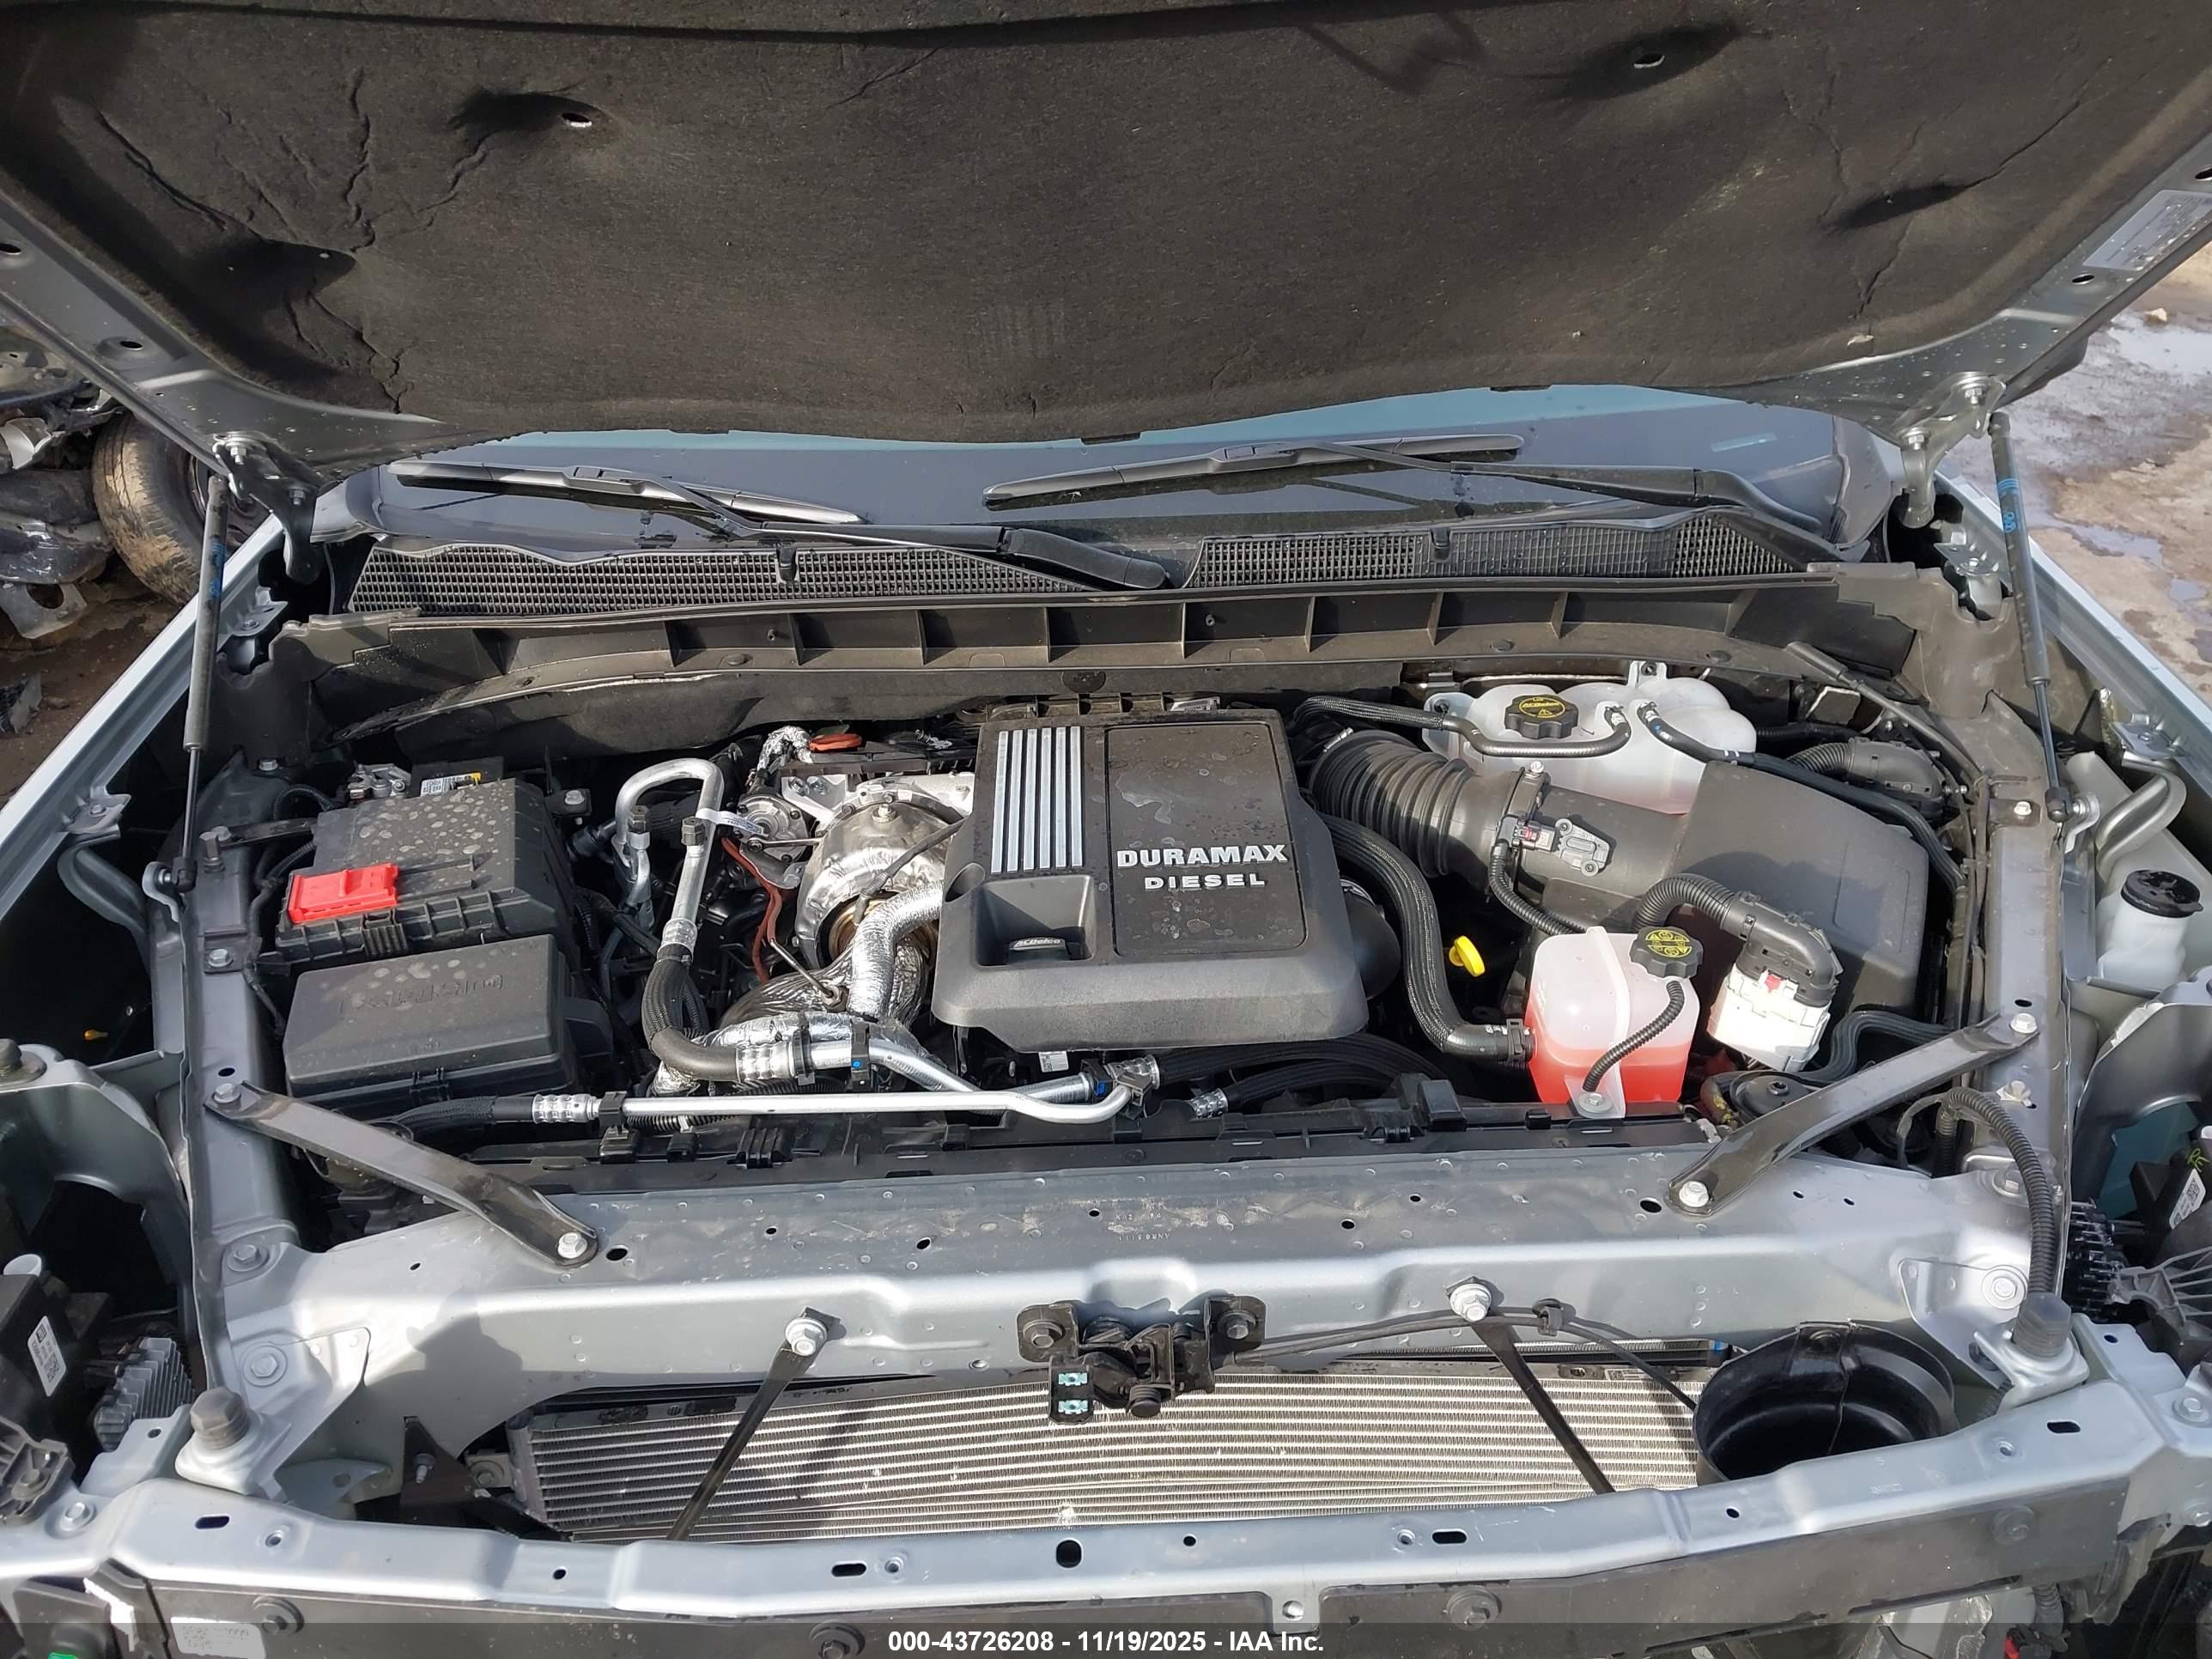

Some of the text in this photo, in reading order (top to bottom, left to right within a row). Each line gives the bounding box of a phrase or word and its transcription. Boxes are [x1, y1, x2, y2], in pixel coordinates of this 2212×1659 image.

[1116, 844, 1288, 867] DURAMAX
[1145, 872, 1266, 890] DIESEL
[1013, 938, 1061, 948] ACDelco
